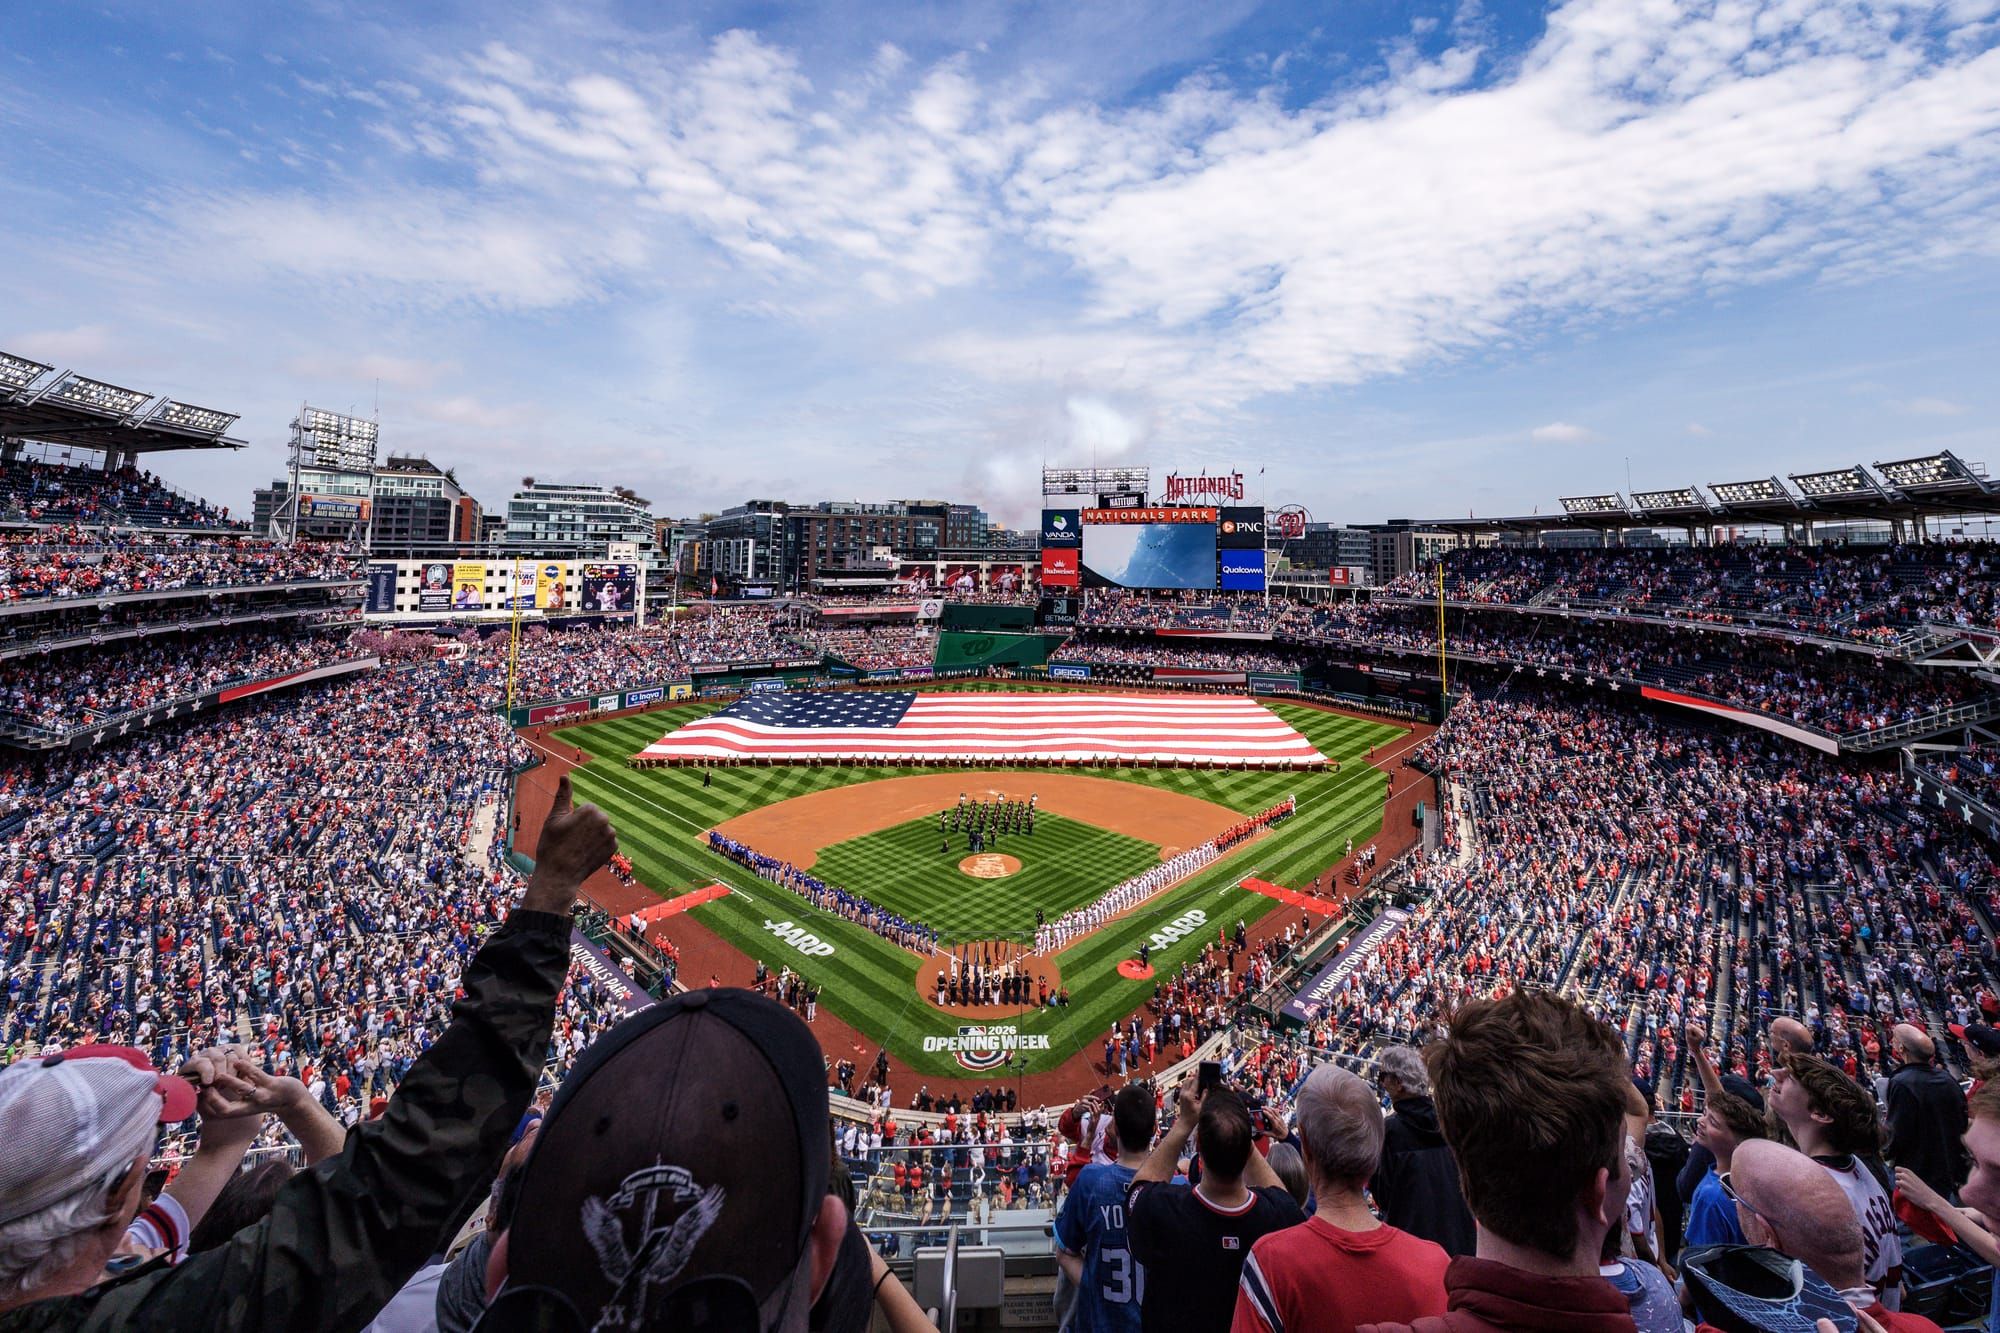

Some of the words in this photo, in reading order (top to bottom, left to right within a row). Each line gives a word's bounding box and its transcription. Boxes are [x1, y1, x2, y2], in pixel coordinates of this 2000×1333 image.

[1167, 474, 1243, 500] NATIONALS
[1087, 511, 1165, 520] NATIONALS
[1172, 510, 1209, 519] PARK
[1236, 522, 1262, 533] PNC
[1043, 567, 1076, 575] Budweiser
[1222, 566, 1263, 575] Qualcomm
[1045, 615, 1076, 624] BETMGM
[1054, 668, 1085, 677] GEICO
[639, 691, 659, 700] Inova
[1148, 909, 1208, 951] AARP
[764, 918, 835, 956] AARP
[1308, 952, 1363, 1000] WASHINGTON
[1356, 919, 1397, 956] NATIONALS
[570, 942, 613, 981] NATIONALS
[603, 977, 634, 1000] PARK
[988, 1025, 1017, 1035] 2026
[923, 1036, 1000, 1052] OPENING
[1001, 1035, 1050, 1050] WEEK
